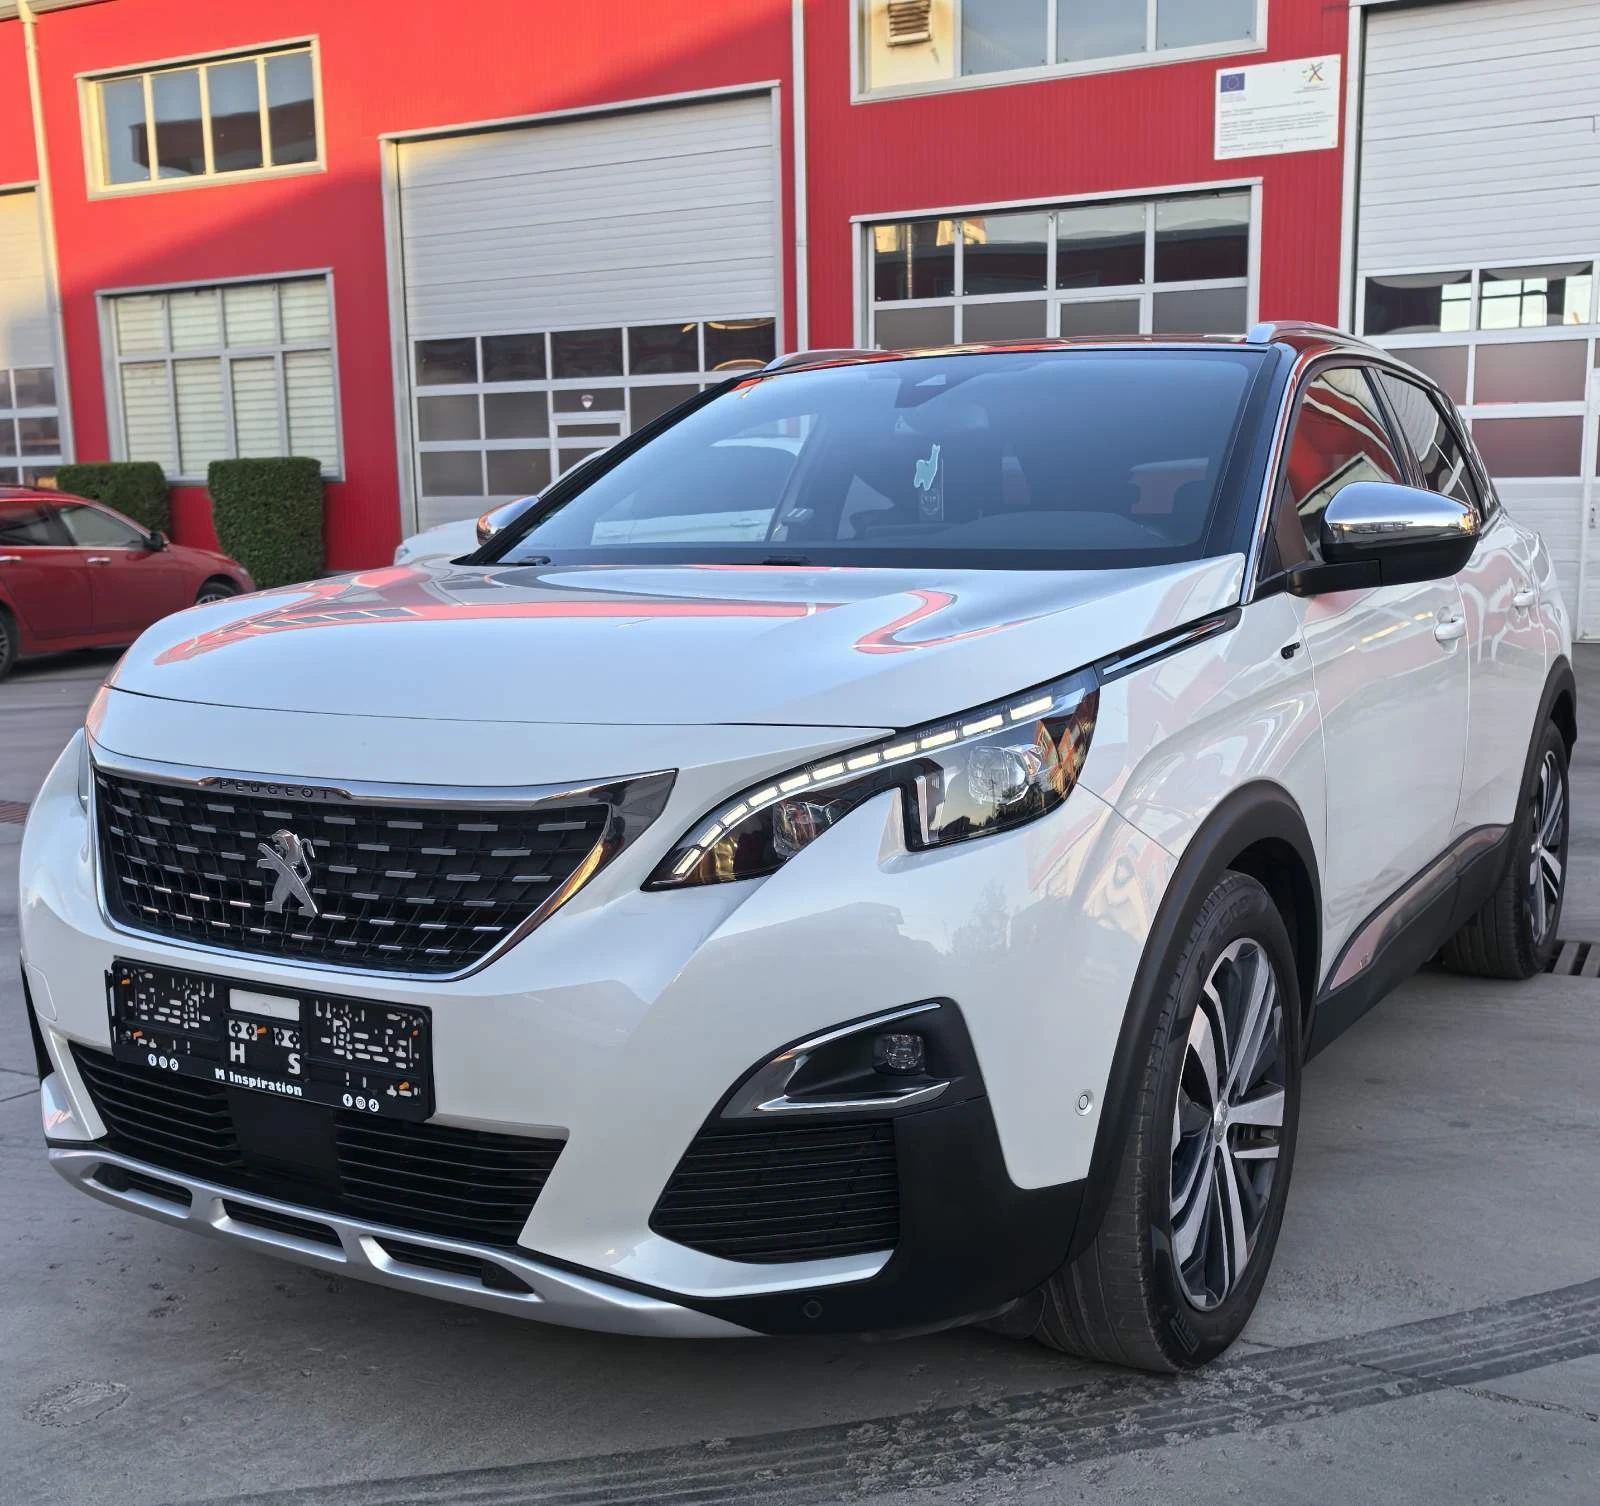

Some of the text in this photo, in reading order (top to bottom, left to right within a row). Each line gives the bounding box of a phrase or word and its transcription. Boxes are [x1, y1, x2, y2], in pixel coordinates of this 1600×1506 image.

[218, 779, 331, 799] PEUGEOT
[229, 1041, 301, 1075] H S
[229, 1071, 303, 1097] Inspiration
